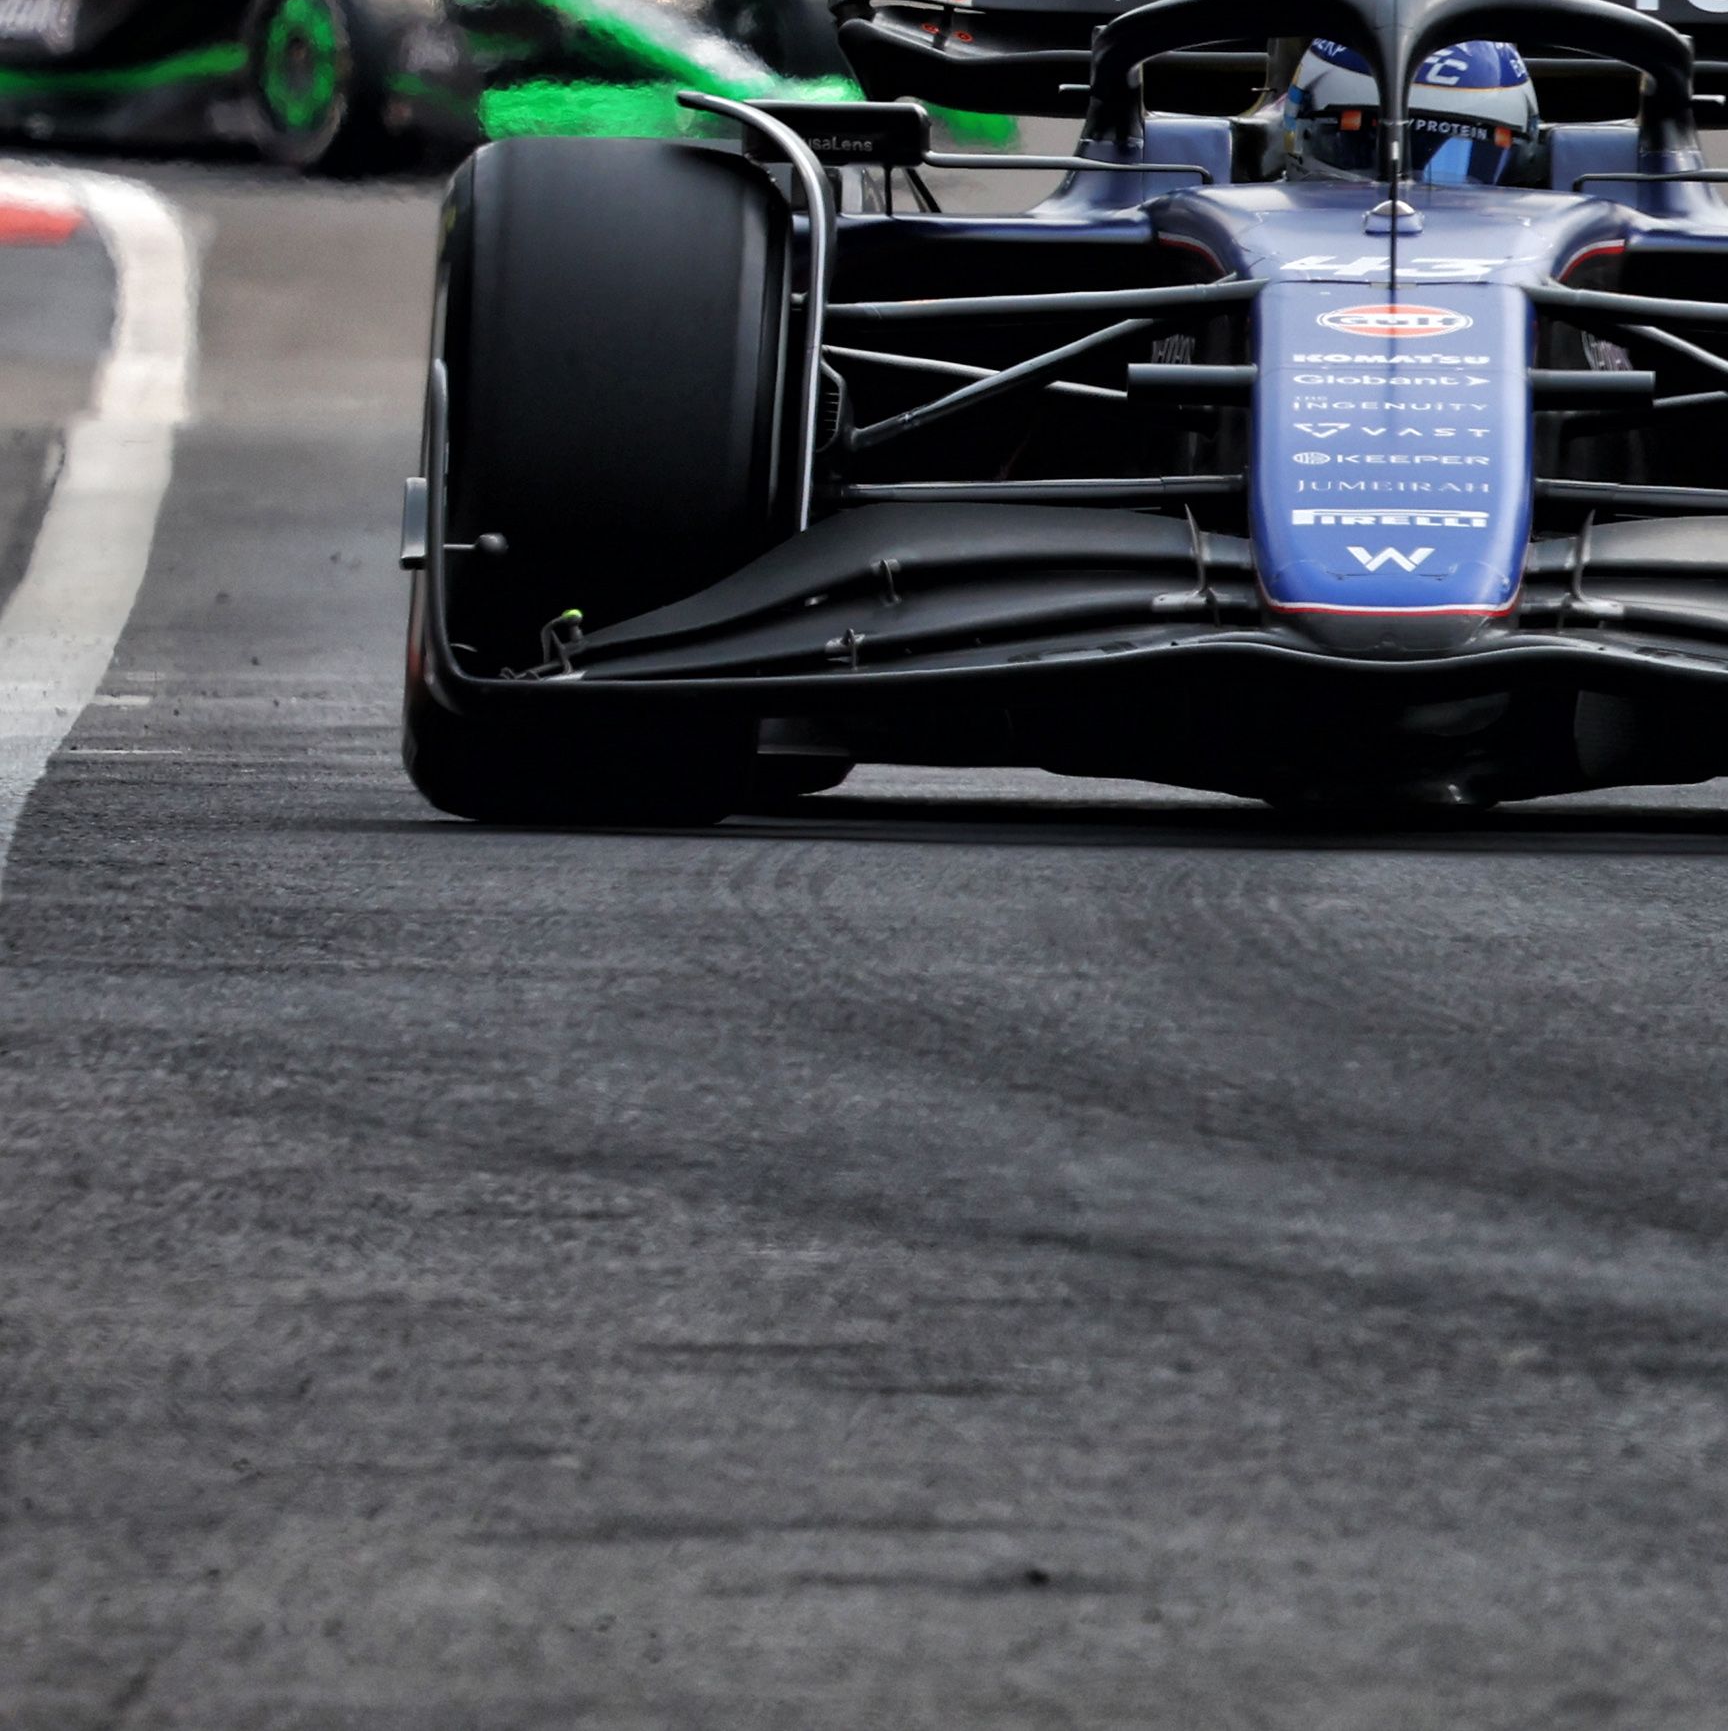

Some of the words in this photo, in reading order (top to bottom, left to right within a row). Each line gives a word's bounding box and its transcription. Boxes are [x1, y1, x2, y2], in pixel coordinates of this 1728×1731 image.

[1280, 255, 1505, 278] 43
[1293, 353, 1490, 365] KOMATSU
[1293, 374, 1460, 385] Globant
[1293, 401, 1488, 411] INGENUITY
[1361, 427, 1491, 438] VAST
[1336, 453, 1491, 466] KEEPER
[1297, 479, 1490, 493] JUMEIRAH
[1292, 508, 1491, 528] PIRELLI
